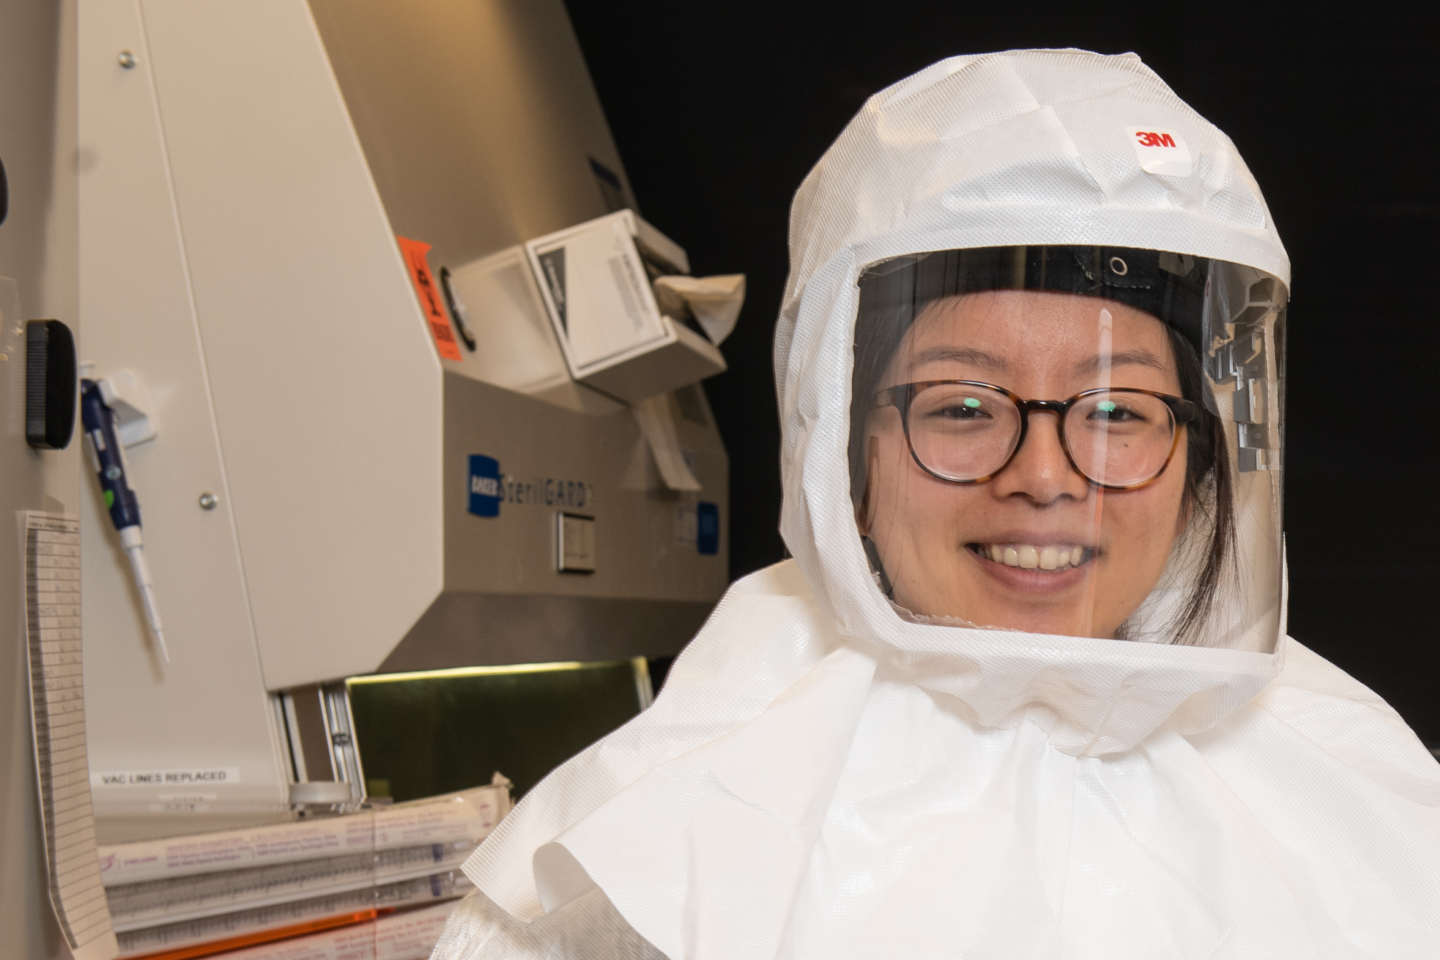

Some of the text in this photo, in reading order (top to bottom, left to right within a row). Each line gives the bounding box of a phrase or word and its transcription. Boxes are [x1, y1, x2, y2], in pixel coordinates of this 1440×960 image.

[1135, 131, 1177, 148] 3M
[102, 770, 227, 785] VAC LINES REPLACED
